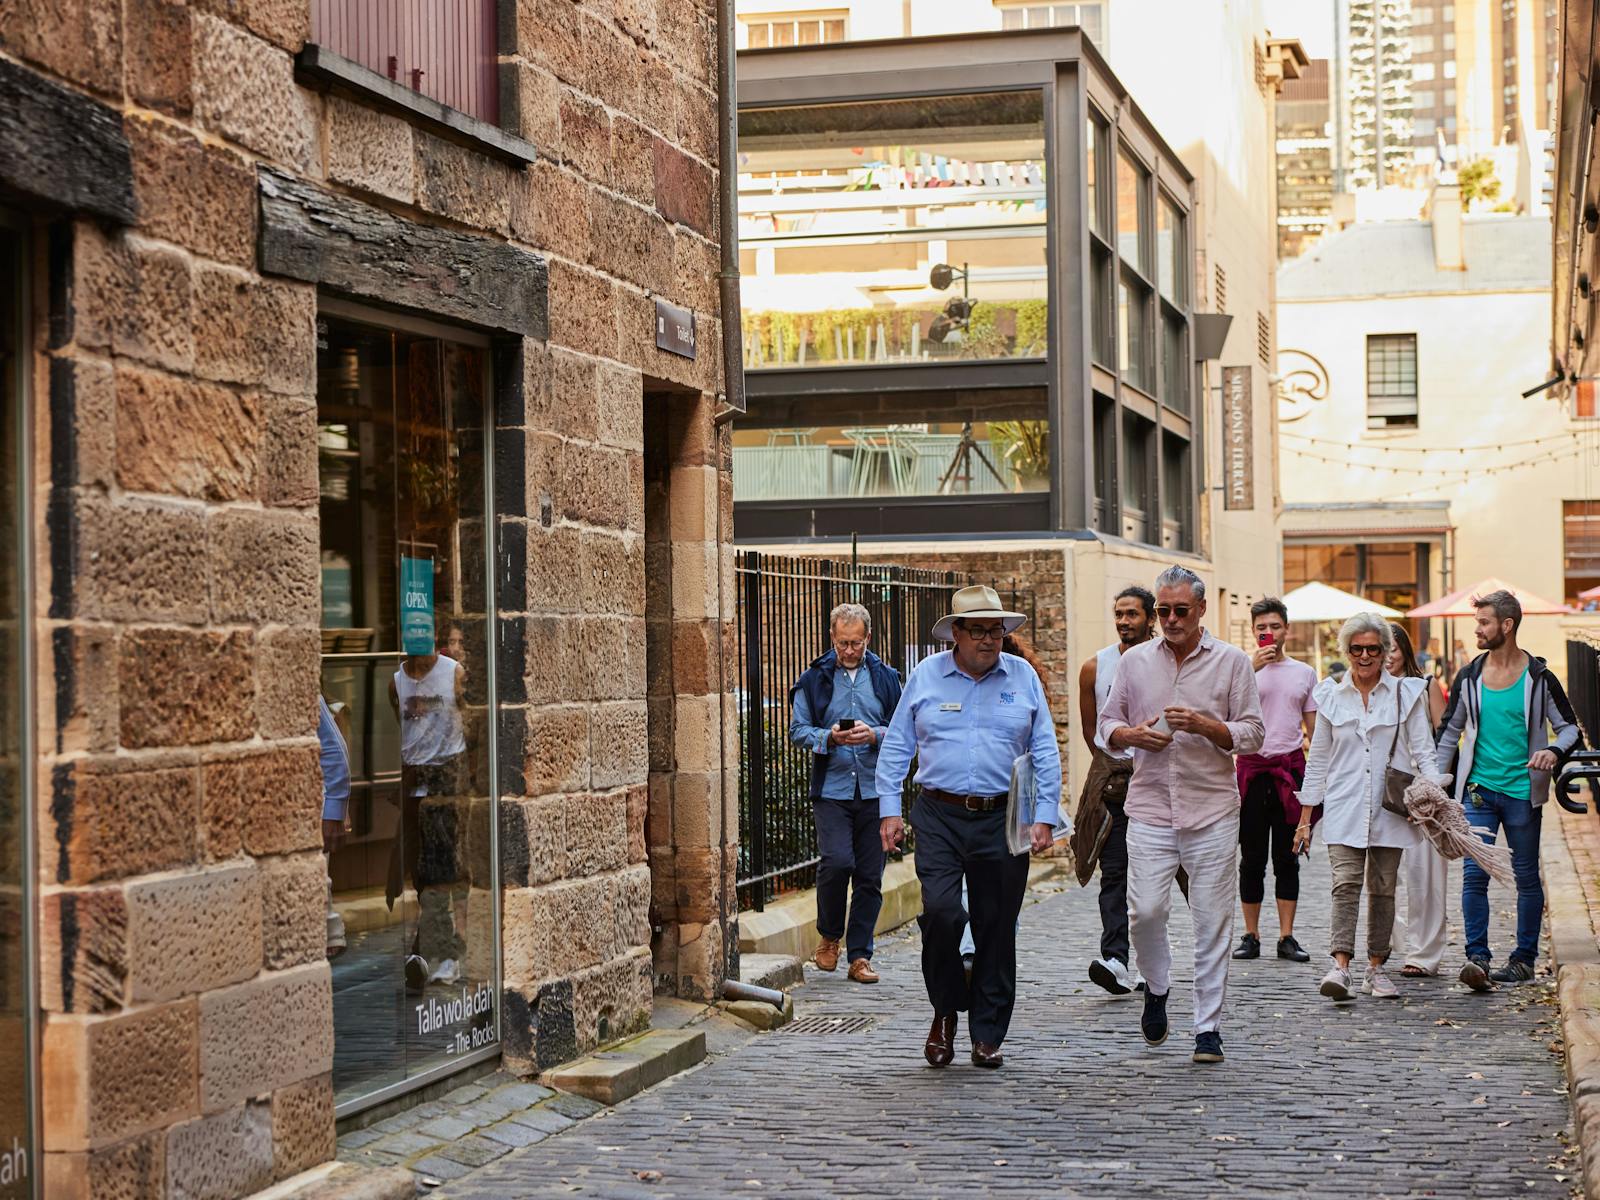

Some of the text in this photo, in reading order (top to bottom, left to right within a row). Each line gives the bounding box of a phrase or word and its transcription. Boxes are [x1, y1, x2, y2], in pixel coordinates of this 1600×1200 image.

[406, 592, 428, 608] OPEN
[415, 980, 494, 1035] Tallawoladah
[455, 1031, 470, 1055] The
[472, 1021, 494, 1048] Rocks
